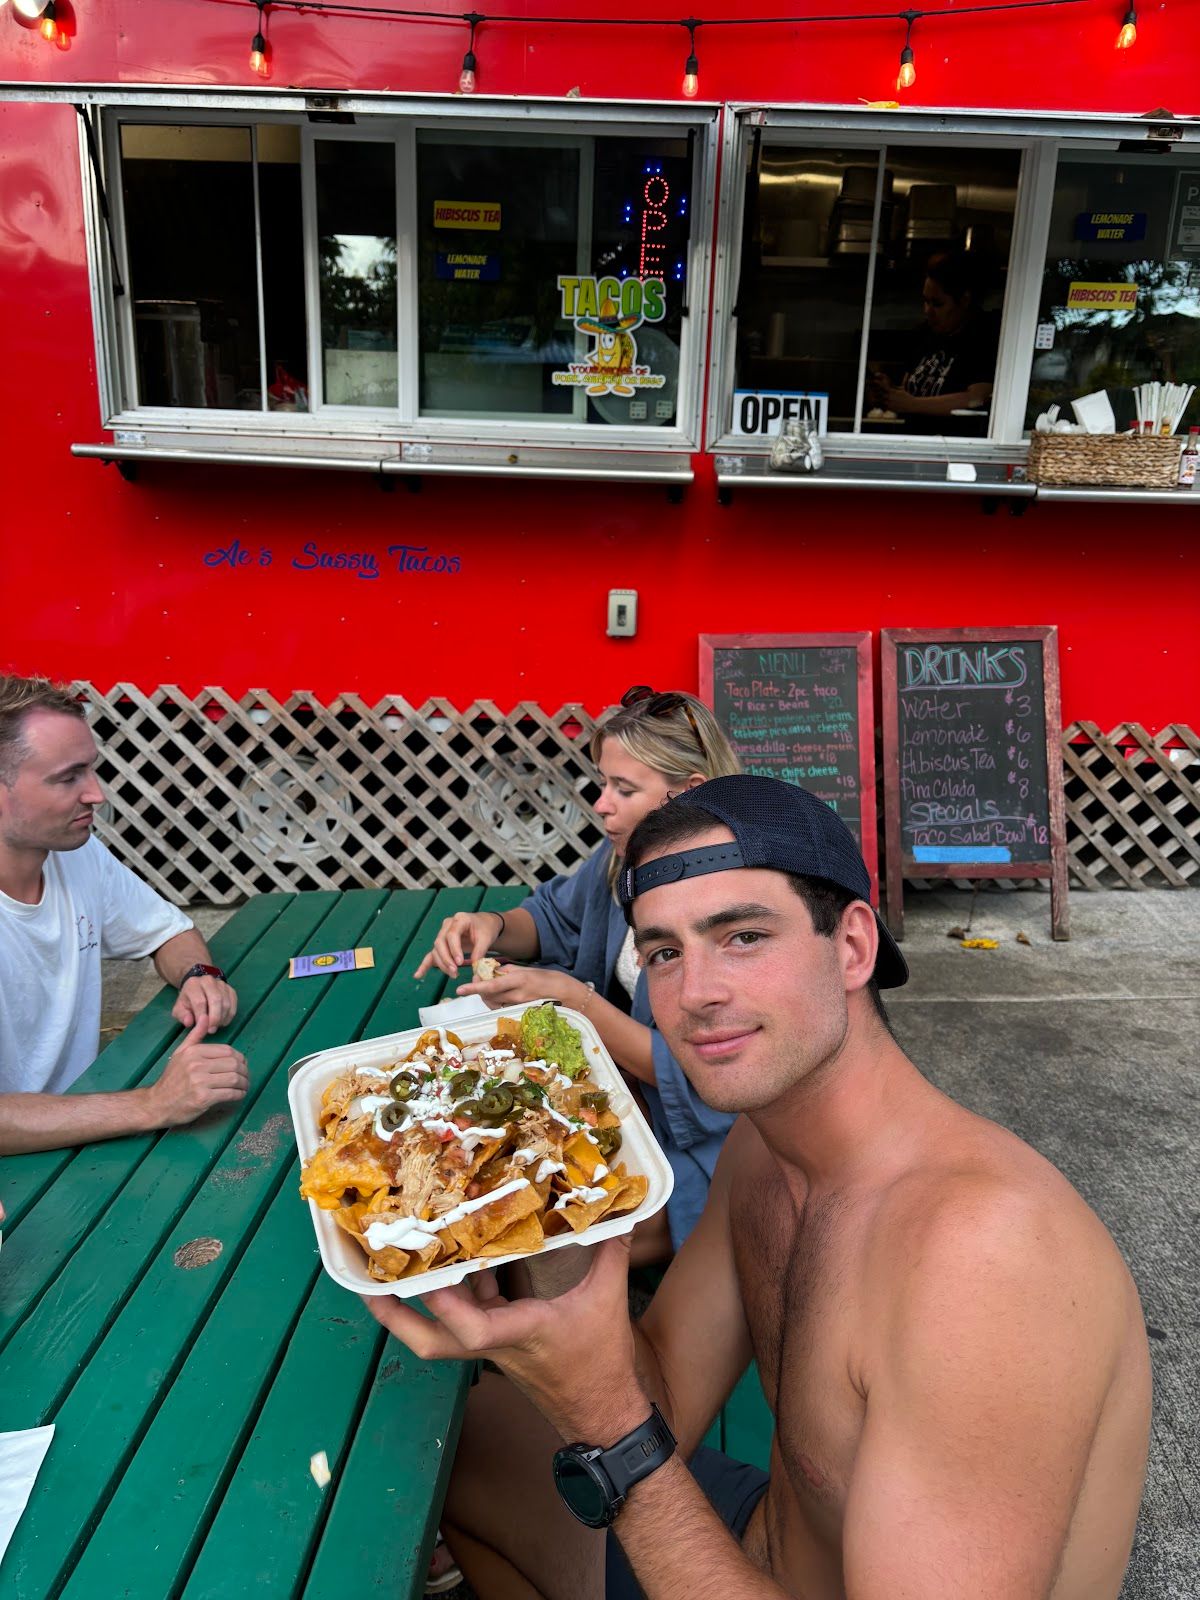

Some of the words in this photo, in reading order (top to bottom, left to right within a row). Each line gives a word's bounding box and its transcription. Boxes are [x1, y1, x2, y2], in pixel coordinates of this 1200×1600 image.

[436, 208, 481, 222] HIBISCUS
[483, 209, 501, 222] TEA
[1091, 213, 1134, 224] LEMONADE
[640, 176, 669, 284] OPE
[1097, 229, 1125, 239] WATER
[447, 254, 487, 265] LEMONADE
[454, 269, 480, 279] WATER
[560, 277, 664, 319] TACOS
[1070, 289, 1117, 302] HIBISCUS
[1119, 290, 1137, 302] TEA
[740, 395, 820, 434] OPEN
[292, 542, 379, 579] Sassy
[387, 545, 461, 573] Tacos
[759, 652, 806, 674] MENU
[904, 644, 1028, 688] DRINKS
[725, 682, 750, 698] Taco
[752, 680, 780, 697] Plate
[813, 683, 838, 697] taco
[747, 701, 767, 711] Rice
[778, 700, 810, 712] Beans
[902, 694, 971, 720] Water
[903, 724, 989, 746] Lemonade
[902, 749, 970, 774] Hibiscus
[970, 748, 996, 769] Tea
[933, 778, 976, 799] Colada
[910, 798, 1001, 825] Specials
[910, 827, 946, 845] Taco
[950, 825, 990, 844] Salad
[992, 822, 1027, 844] Bowl
